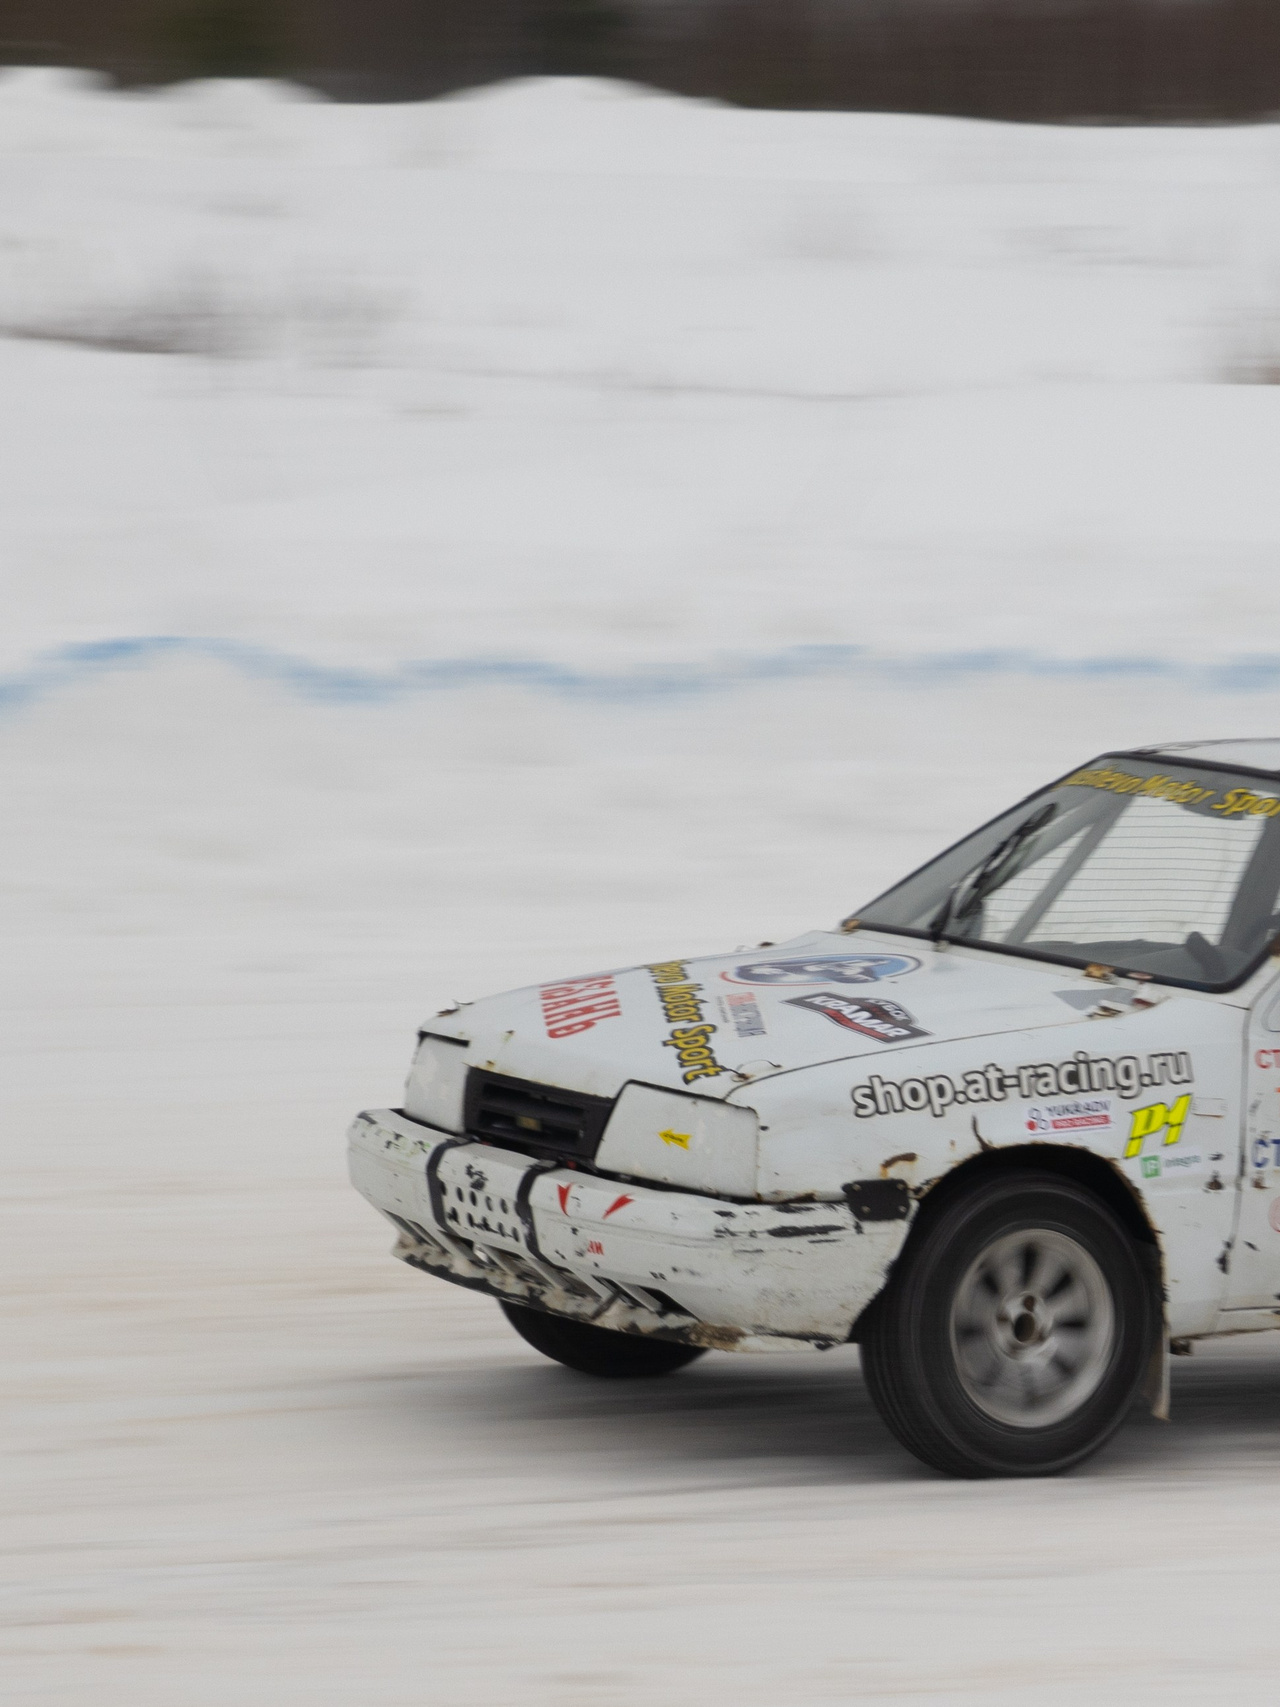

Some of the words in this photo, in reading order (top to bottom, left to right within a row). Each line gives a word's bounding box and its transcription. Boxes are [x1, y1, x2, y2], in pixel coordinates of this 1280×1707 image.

[655, 983, 708, 1023] Motor
[804, 995, 912, 1038] KRAMAR
[661, 1023, 727, 1085] Sport
[852, 1050, 1194, 1118] shop.at-racing.ru
